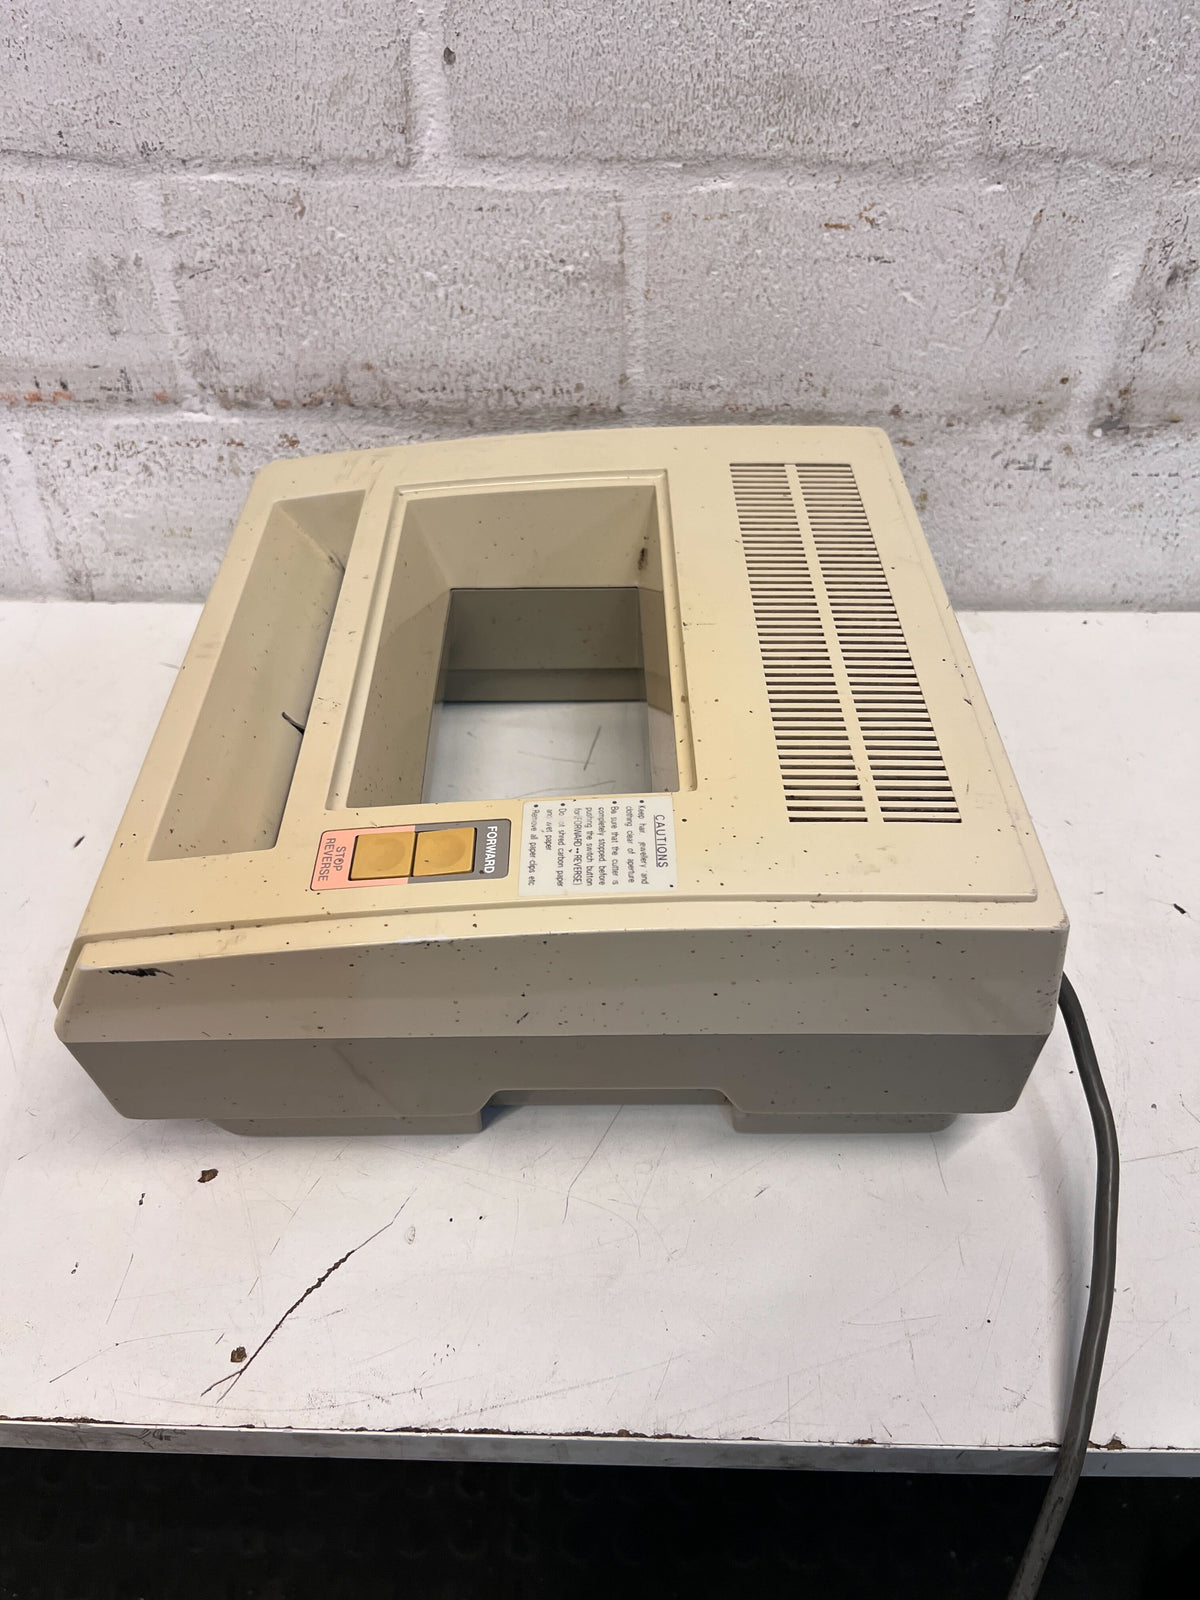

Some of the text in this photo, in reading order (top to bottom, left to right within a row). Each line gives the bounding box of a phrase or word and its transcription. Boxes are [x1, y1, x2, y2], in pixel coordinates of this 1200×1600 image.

[558, 808, 567, 816] Do
[611, 806, 619, 814] Be
[625, 806, 633, 826] clothing
[638, 805, 646, 819] Keep
[531, 810, 540, 831] Remove
[544, 835, 552, 850] paper
[611, 832, 619, 842] that
[655, 815, 668, 868] CAUTIONS
[484, 826, 497, 874] FORWARD
[528, 842, 536, 858] paper
[584, 807, 594, 886] pushing the switch button
[597, 807, 607, 885] completely stopped before
[318, 838, 336, 882] REVERSE
[333, 846, 346, 872] STOP
[528, 860, 538, 873] clips
[556, 871, 564, 886] paper
[626, 859, 635, 883] aperture
[641, 873, 649, 884] and
[528, 876, 536, 886] etc
